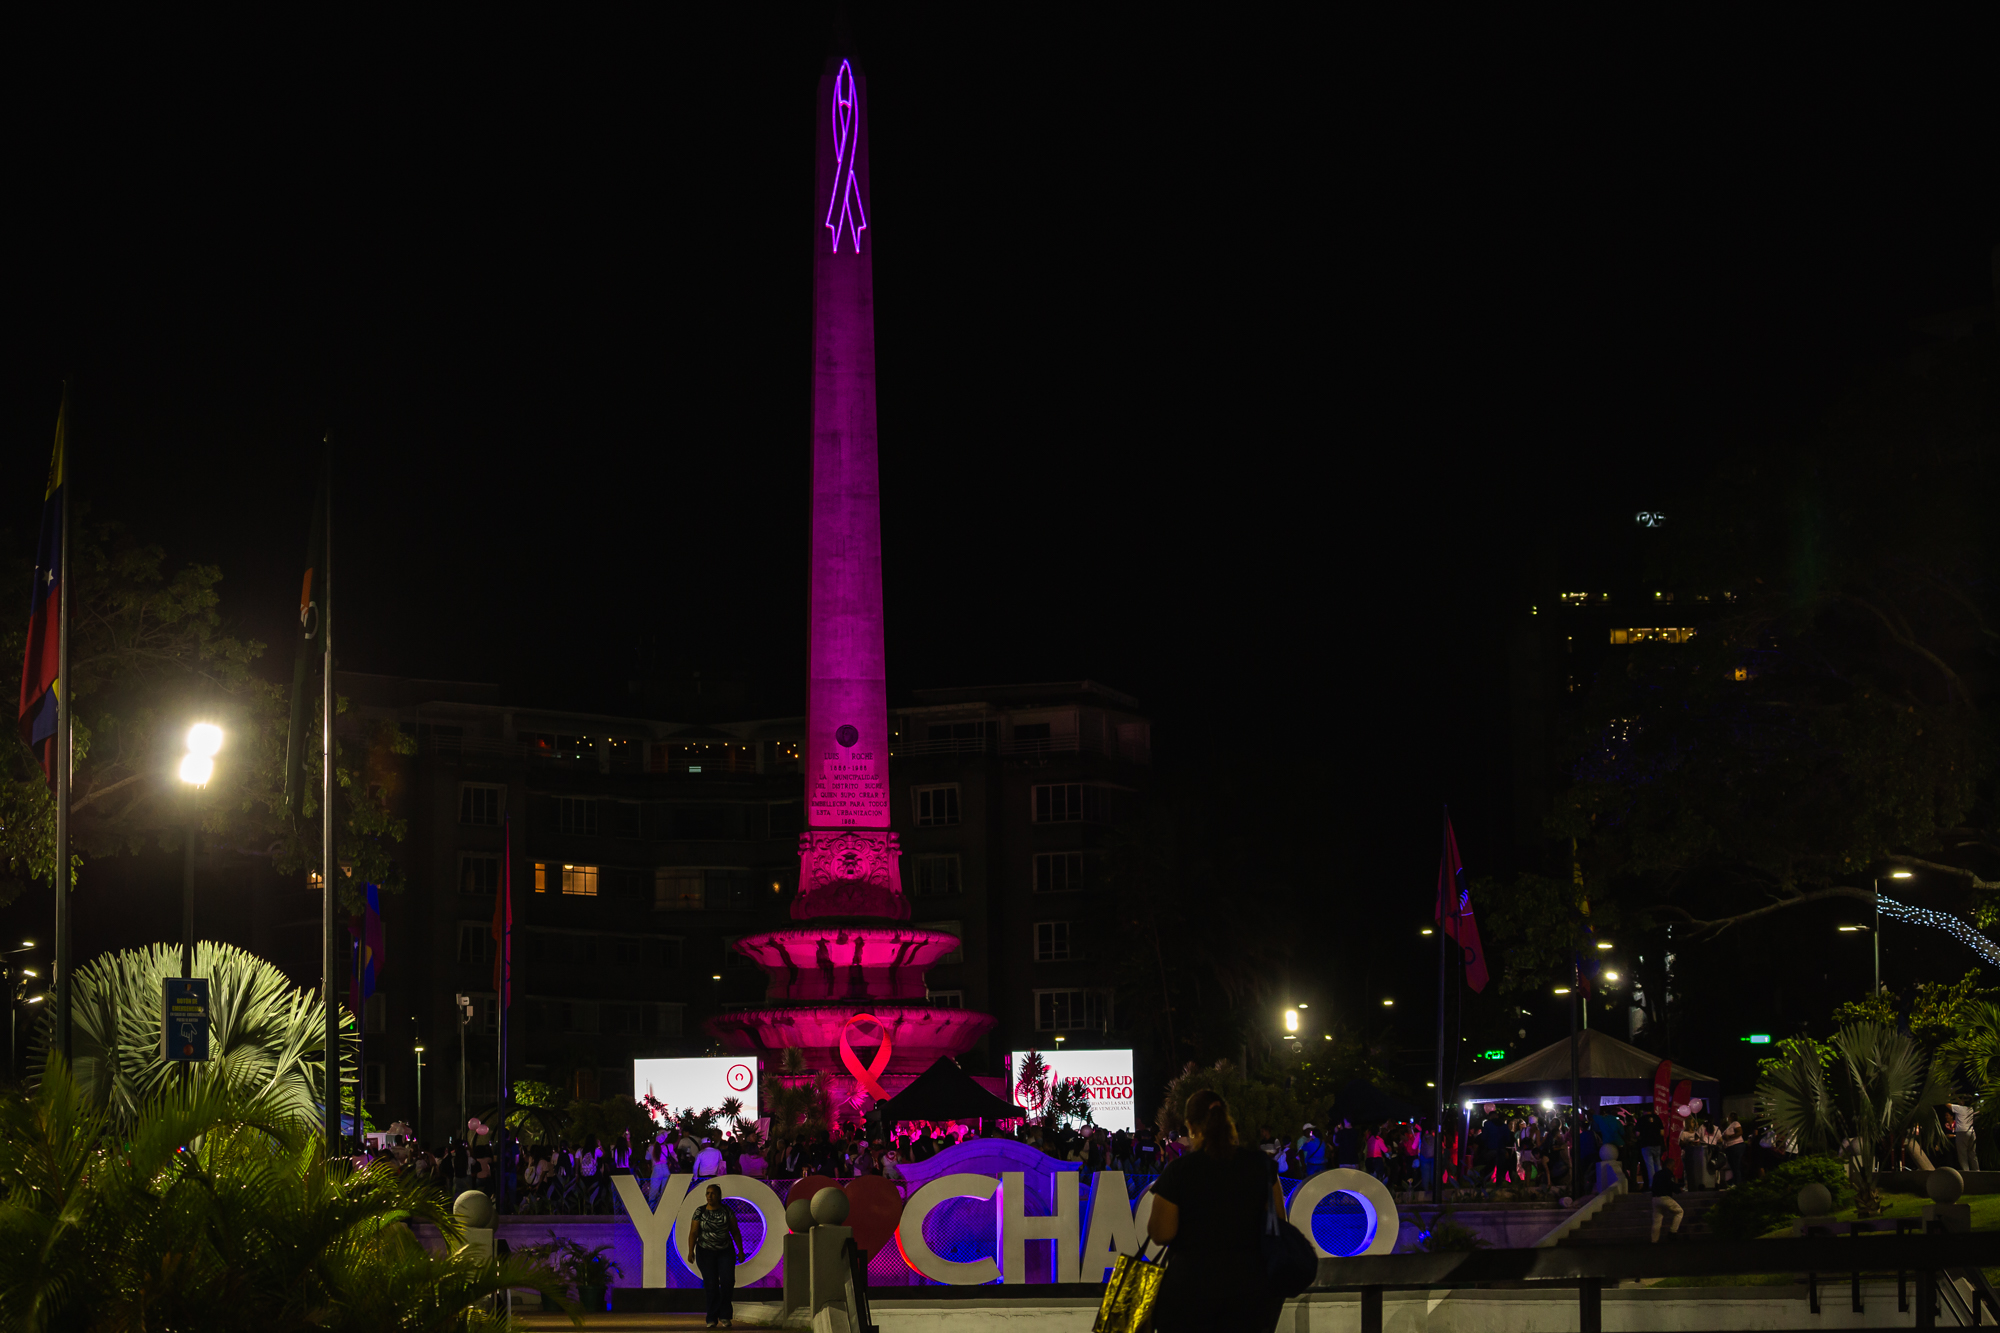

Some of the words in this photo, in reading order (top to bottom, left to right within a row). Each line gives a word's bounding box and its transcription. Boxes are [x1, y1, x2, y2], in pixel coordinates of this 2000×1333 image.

[824, 752, 840, 760] LUIS
[851, 752, 874, 760] ROCHE
[1067, 1086, 1133, 1099] NTIGO
[611, 1173, 787, 1288] YO
[900, 1167, 1400, 1285] CHAO
